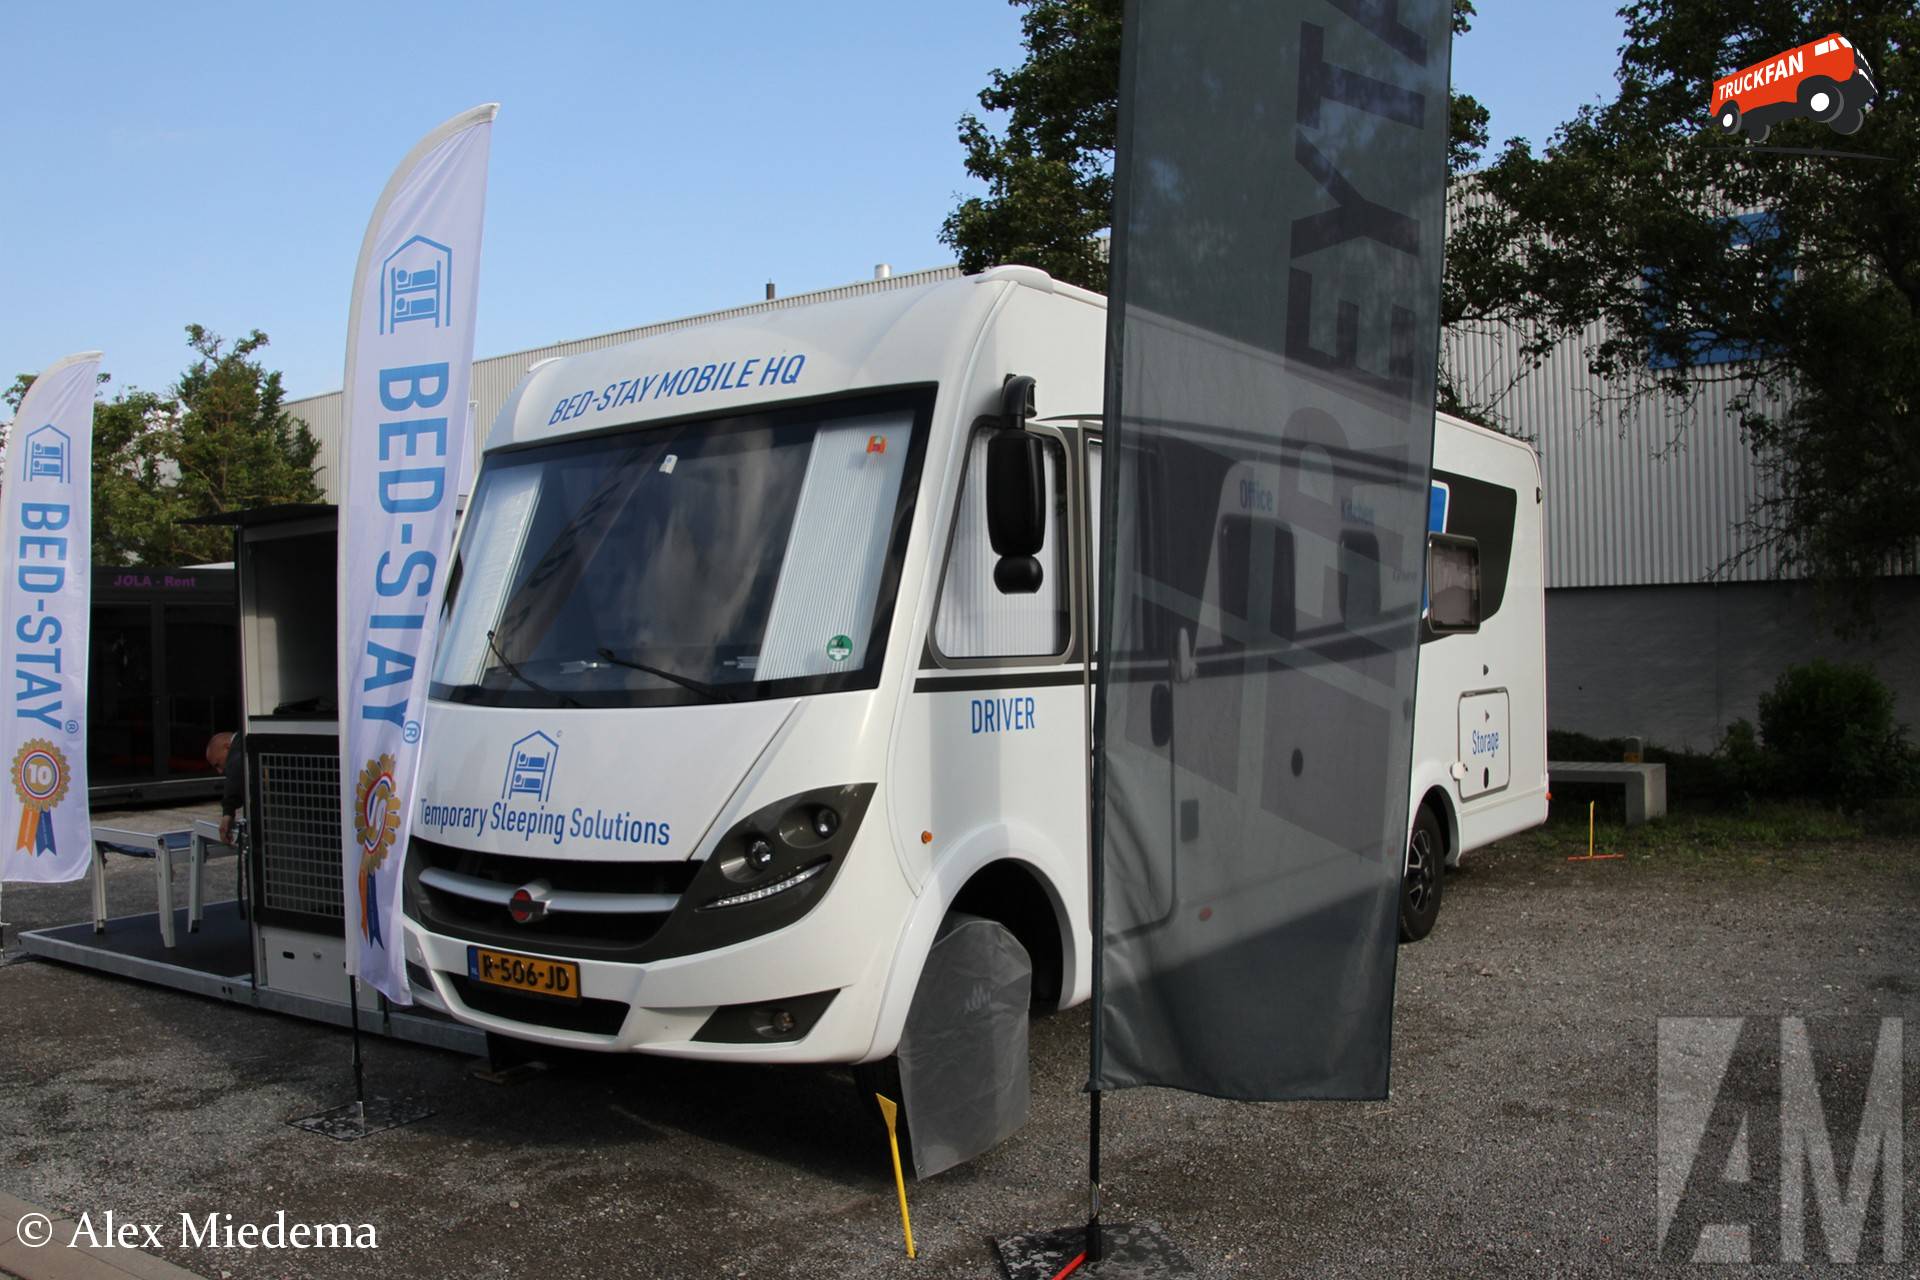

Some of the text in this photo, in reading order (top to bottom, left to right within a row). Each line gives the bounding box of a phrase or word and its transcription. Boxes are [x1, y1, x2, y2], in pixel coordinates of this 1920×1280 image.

[547, 353, 807, 426] BED-STAY MOBILE HQ
[113, 574, 152, 587] JOLA
[164, 575, 196, 587] Rent
[971, 696, 1035, 735] DRIVER
[1472, 729, 1499, 758] Storage
[29, 764, 52, 785] 10
[420, 798, 488, 837] Temporary
[490, 801, 567, 845] Sleeping
[569, 806, 672, 846] Solutions
[483, 954, 570, 992] R-506-JD
